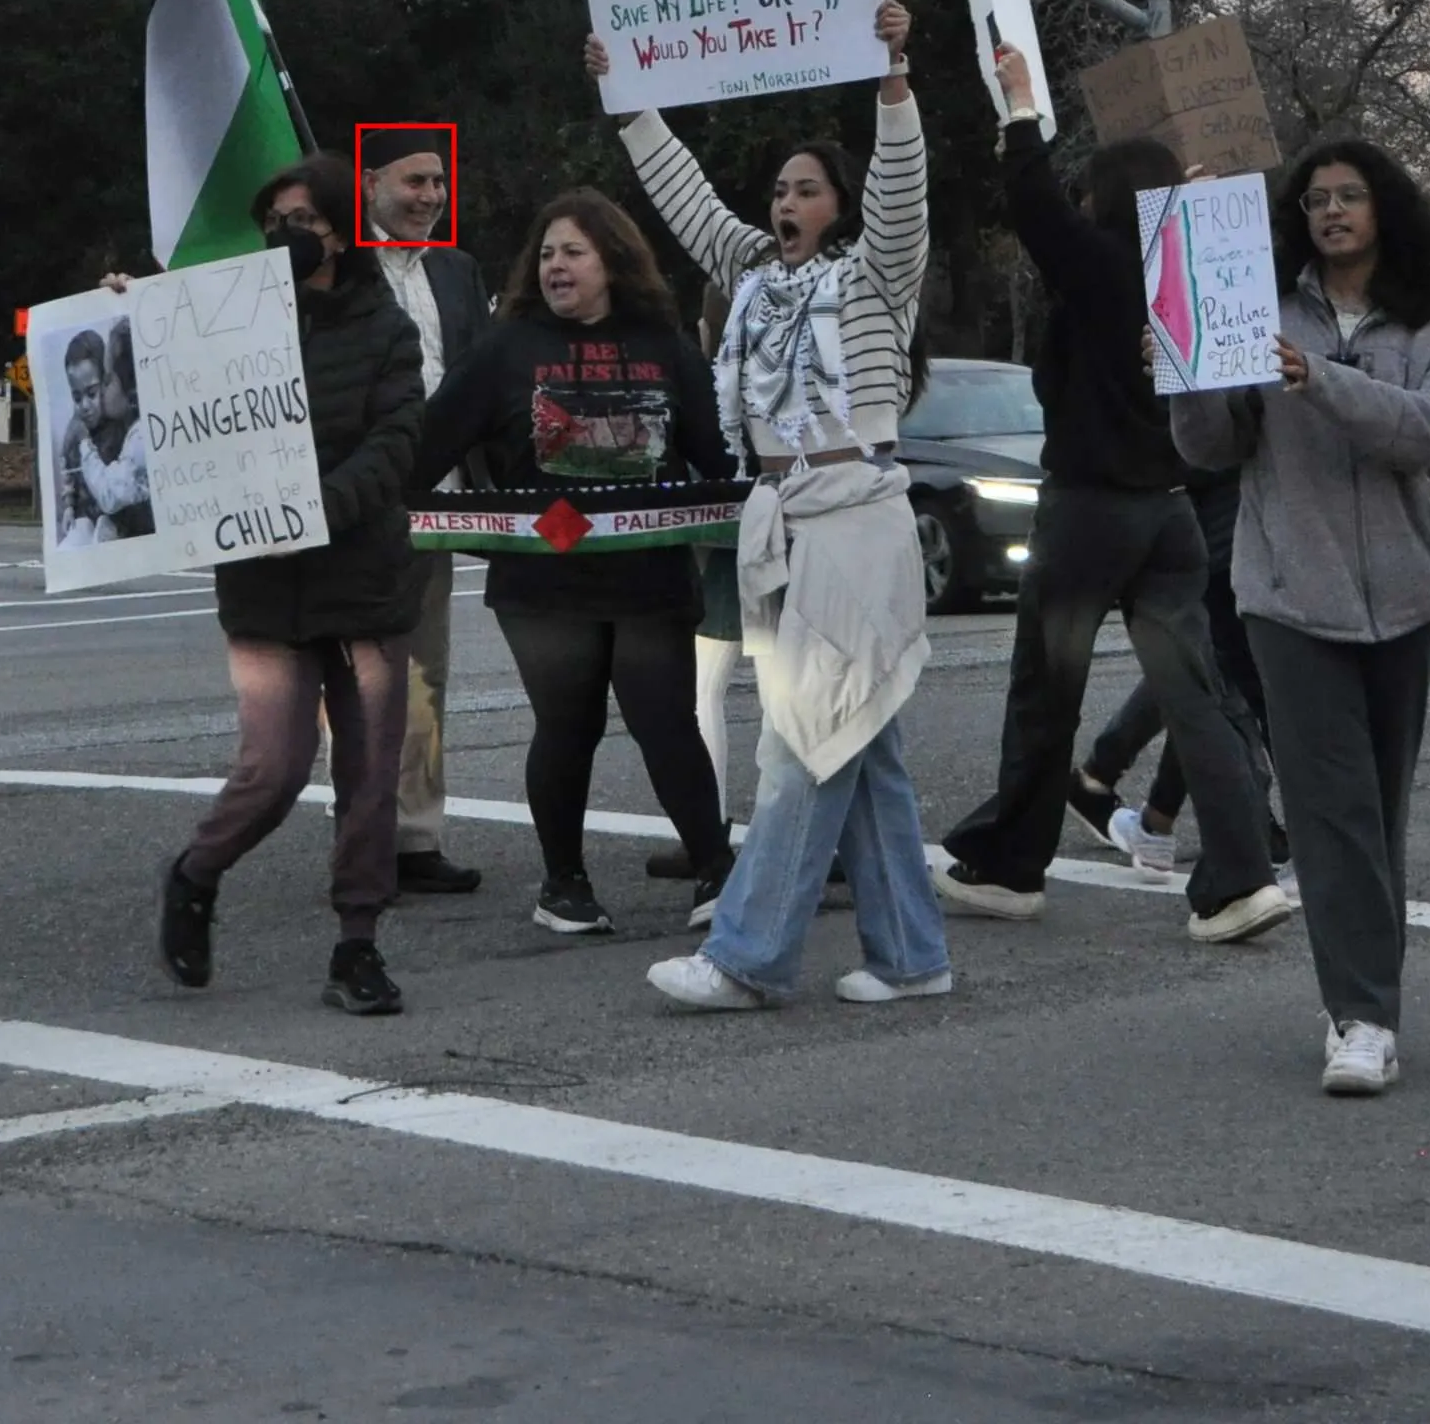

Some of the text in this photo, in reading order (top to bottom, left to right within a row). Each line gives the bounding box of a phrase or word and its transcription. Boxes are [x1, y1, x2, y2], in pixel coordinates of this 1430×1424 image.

[611, 5, 649, 31] SAVE
[633, 35, 689, 71] WOULD
[693, 25, 727, 59] YOU
[728, 18, 776, 53] TAKE
[753, 67, 831, 91] MORRISON
[1192, 190, 1262, 236] FROM
[1215, 265, 1255, 291] SEA
[1215, 326, 1267, 348] WILL BE
[224, 331, 293, 387] most
[1208, 343, 1276, 381] FREE
[147, 377, 308, 452] DANGEROUS
[153, 438, 309, 497] place in the
[167, 479, 301, 527] world to be
[409, 504, 738, 533] PALESTINE PALESTINE
